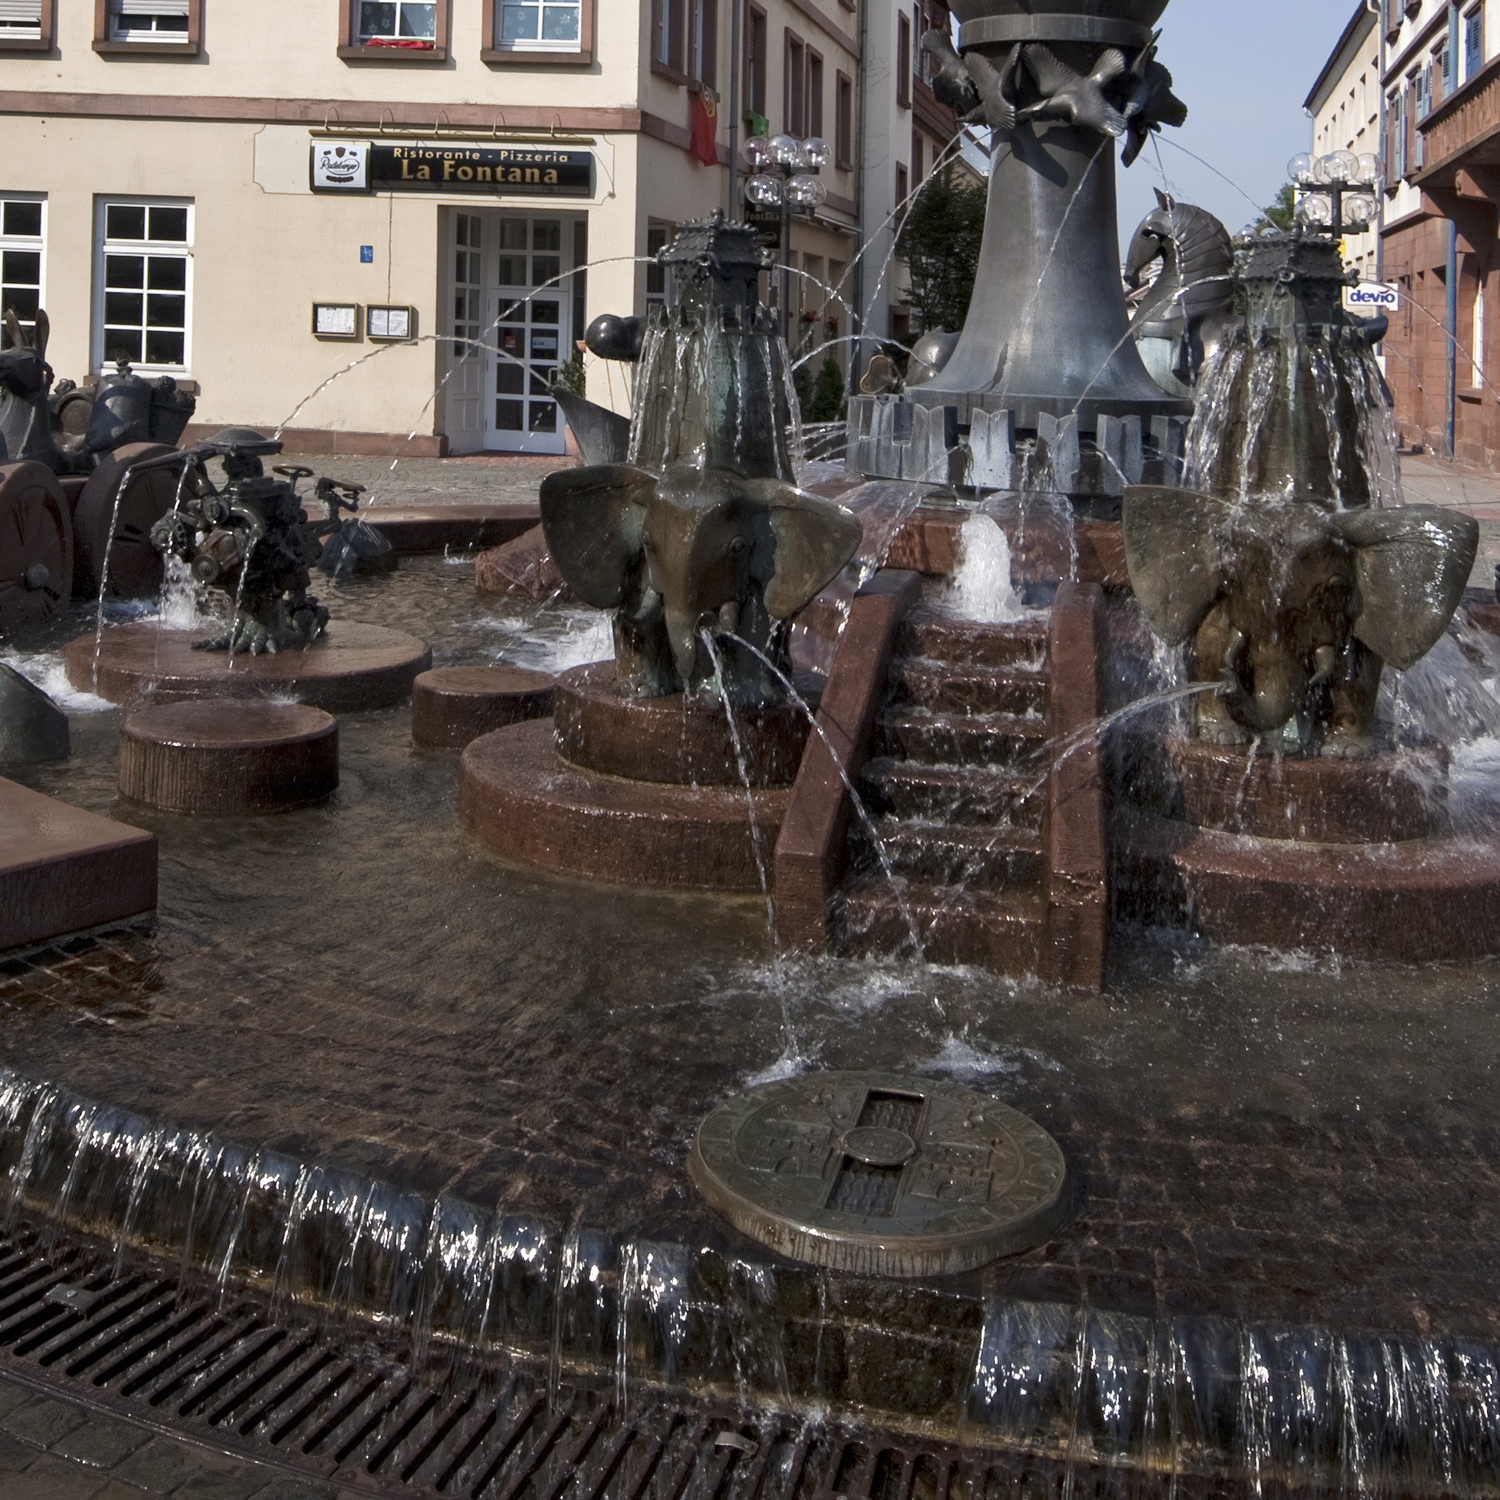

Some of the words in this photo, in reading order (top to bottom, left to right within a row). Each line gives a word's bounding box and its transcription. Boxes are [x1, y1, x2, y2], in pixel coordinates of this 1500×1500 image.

[393, 148, 480, 160] Ristorante
[500, 151, 568, 163] Pizzeria
[402, 159, 430, 180] La
[443, 160, 558, 184] Fontana
[745, 211, 780, 221] Fontana
[1350, 289, 1395, 303] devio
